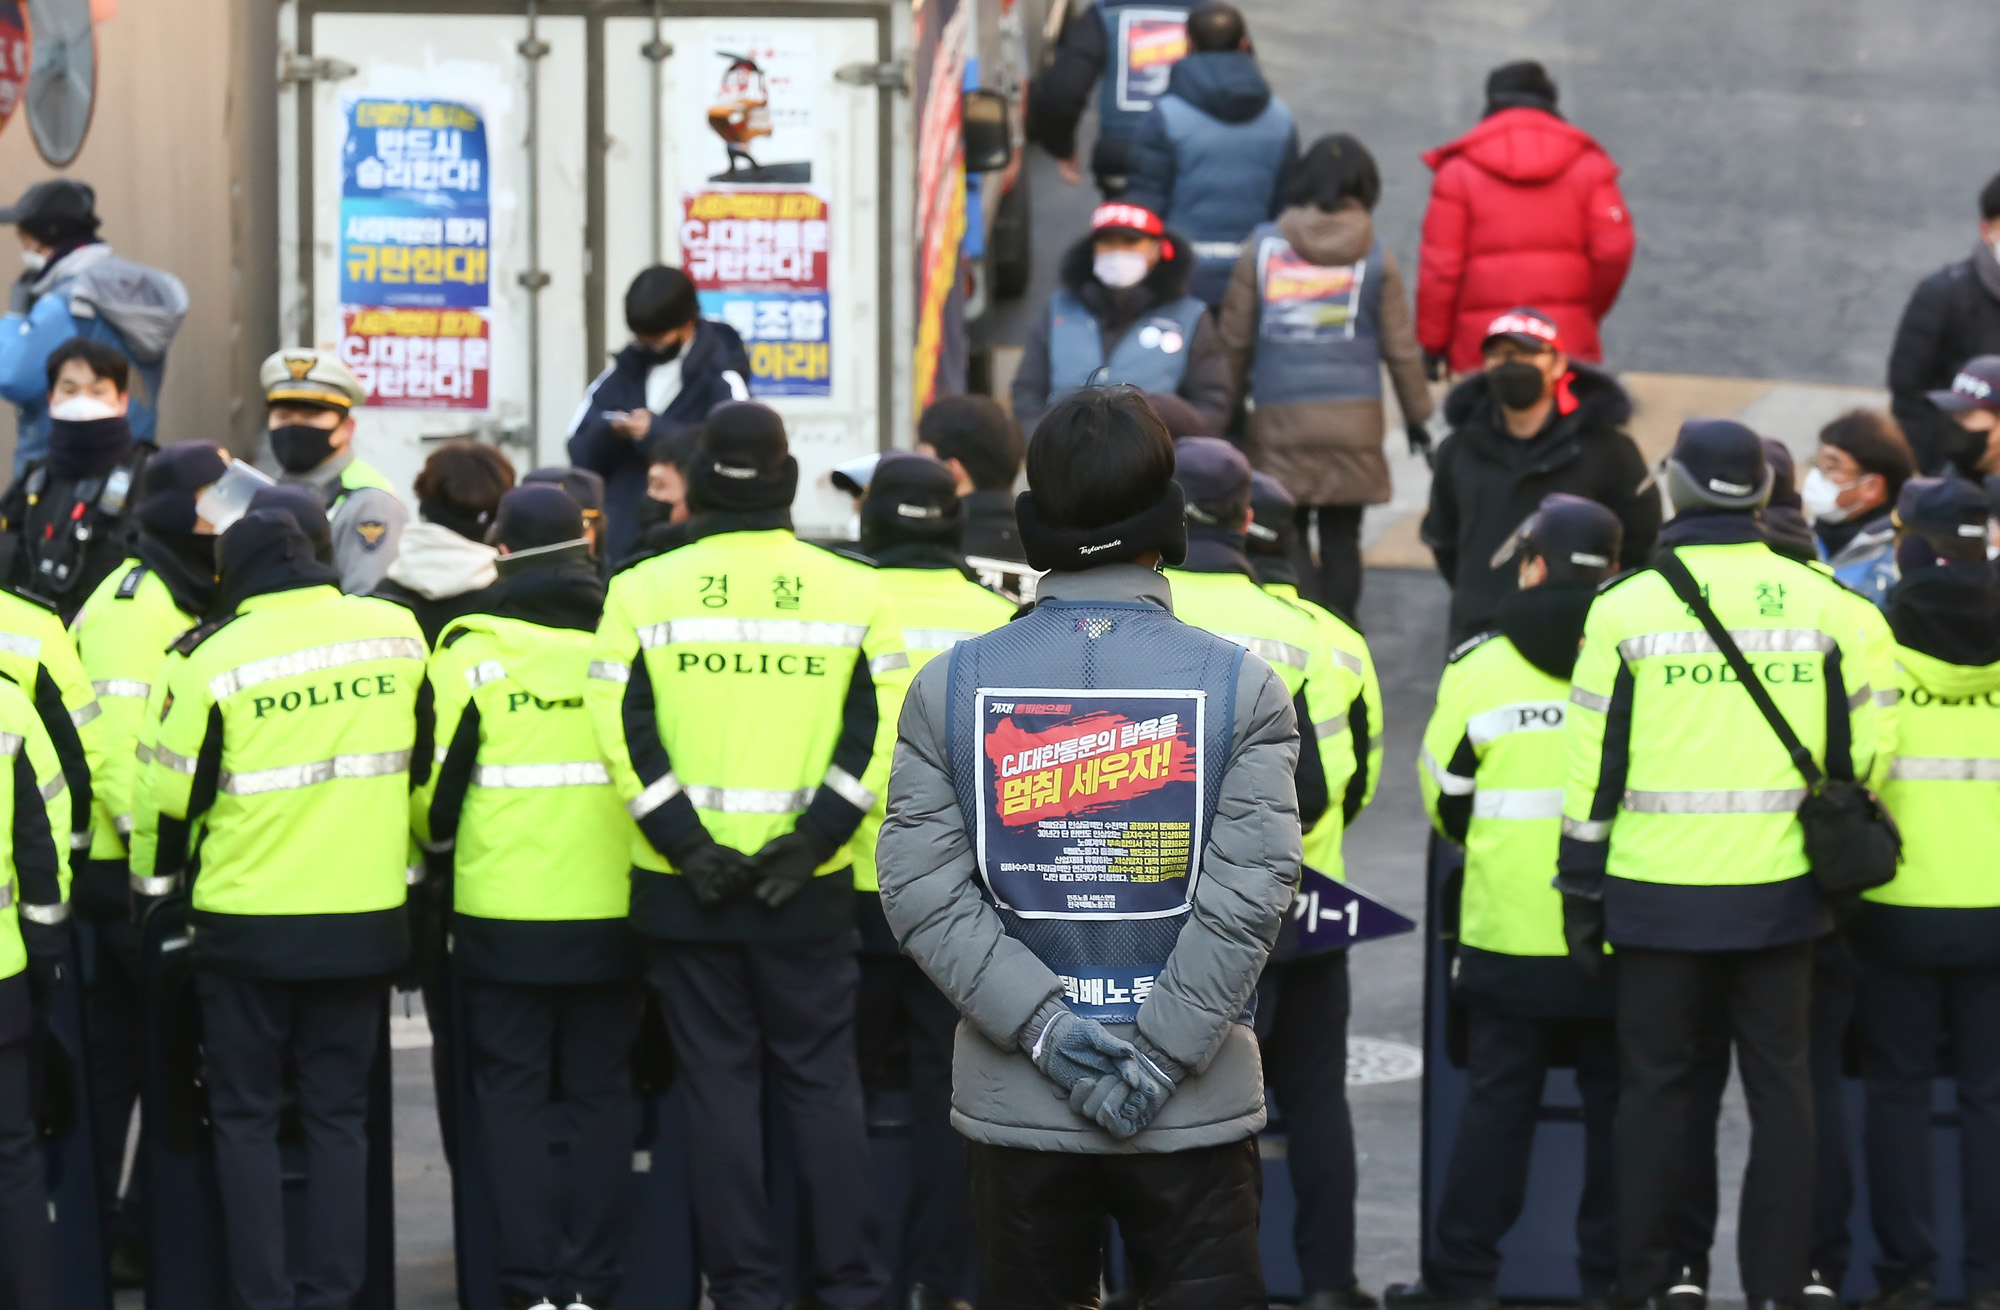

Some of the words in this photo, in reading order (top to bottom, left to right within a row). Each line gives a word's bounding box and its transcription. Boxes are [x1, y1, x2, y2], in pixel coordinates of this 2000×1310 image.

[376, 129, 462, 160] 반드시
[356, 156, 480, 192] 승리한다!
[680, 219, 828, 252] CJ대한통운
[347, 244, 487, 285] 규탄한다!
[688, 249, 814, 281] 규탄한다!
[712, 300, 828, 341] 동조합
[341, 336, 488, 370] CJ대한통운
[744, 341, 829, 381] 하라!
[353, 367, 474, 399] 규탄한다!
[677, 652, 826, 676] POLICE
[1664, 662, 1814, 686] POLCE
[253, 674, 395, 718] POLICE
[989, 702, 1015, 715] 가자!
[1519, 707, 1562, 727] PO
[1001, 728, 1117, 778] CJ대한통운의
[1120, 713, 1179, 749] 탐욕을
[1003, 767, 1063, 816] 멈춰
[1068, 740, 1172, 798] 세우자!
[1037, 830, 1060, 838] 30년간
[1061, 830, 1069, 838] 단
[1160, 831, 1190, 839] 인상하라!
[1075, 873, 1097, 881] 모두가
[1131, 874, 1159, 882] 노동조합
[1058, 975, 1155, 1006] 택배노동
